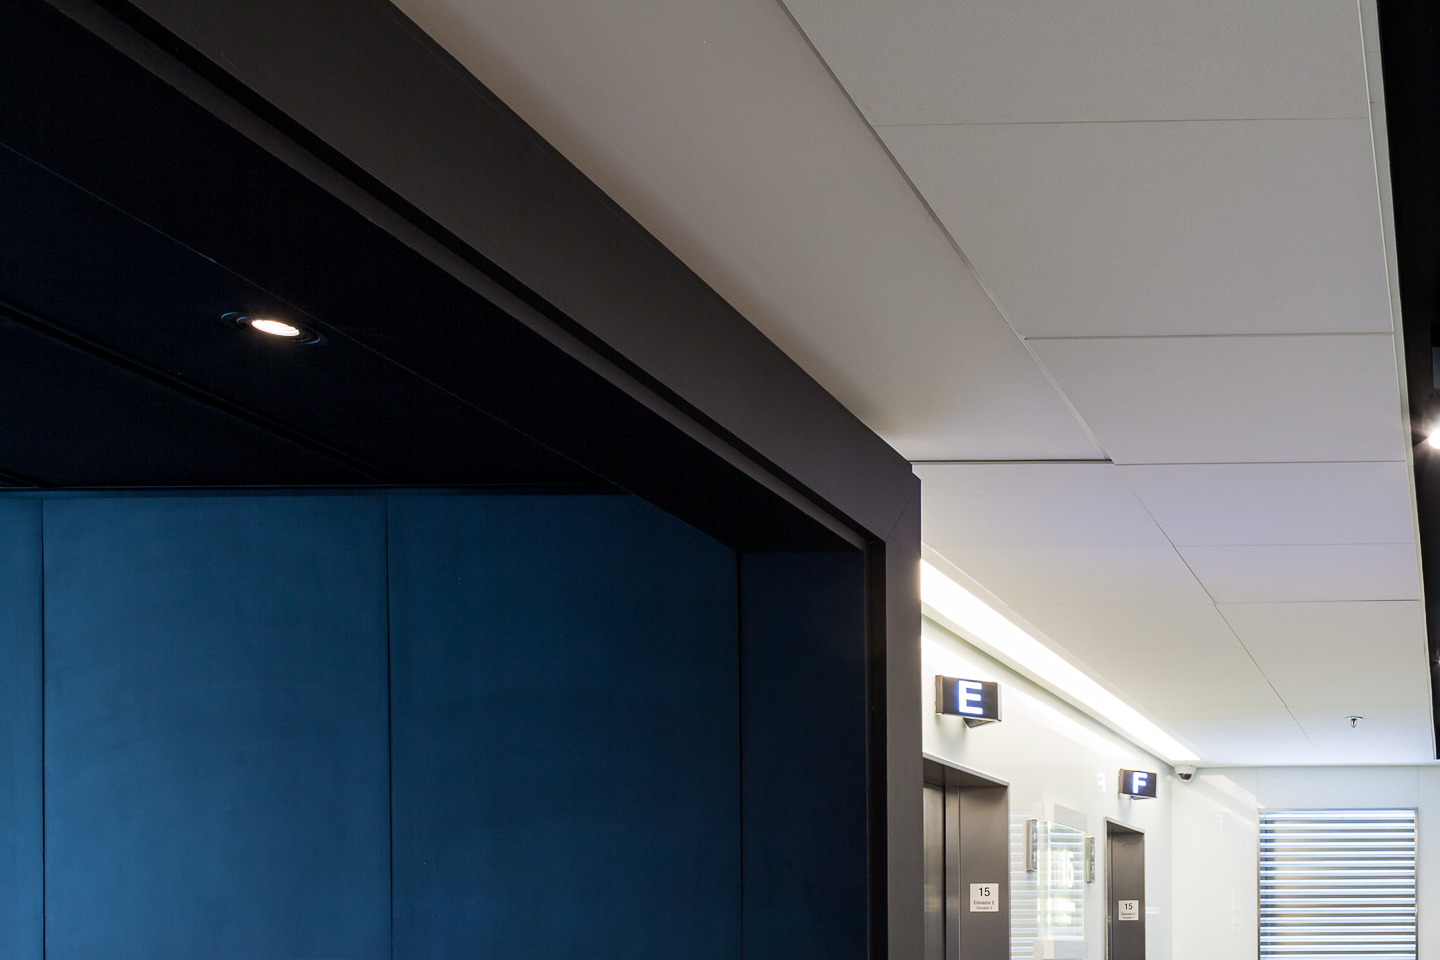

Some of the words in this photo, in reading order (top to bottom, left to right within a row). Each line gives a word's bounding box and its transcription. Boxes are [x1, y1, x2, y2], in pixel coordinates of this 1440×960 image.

[958, 680, 983, 714] E
[1133, 771, 1148, 794] F
[979, 887, 990, 897] 15
